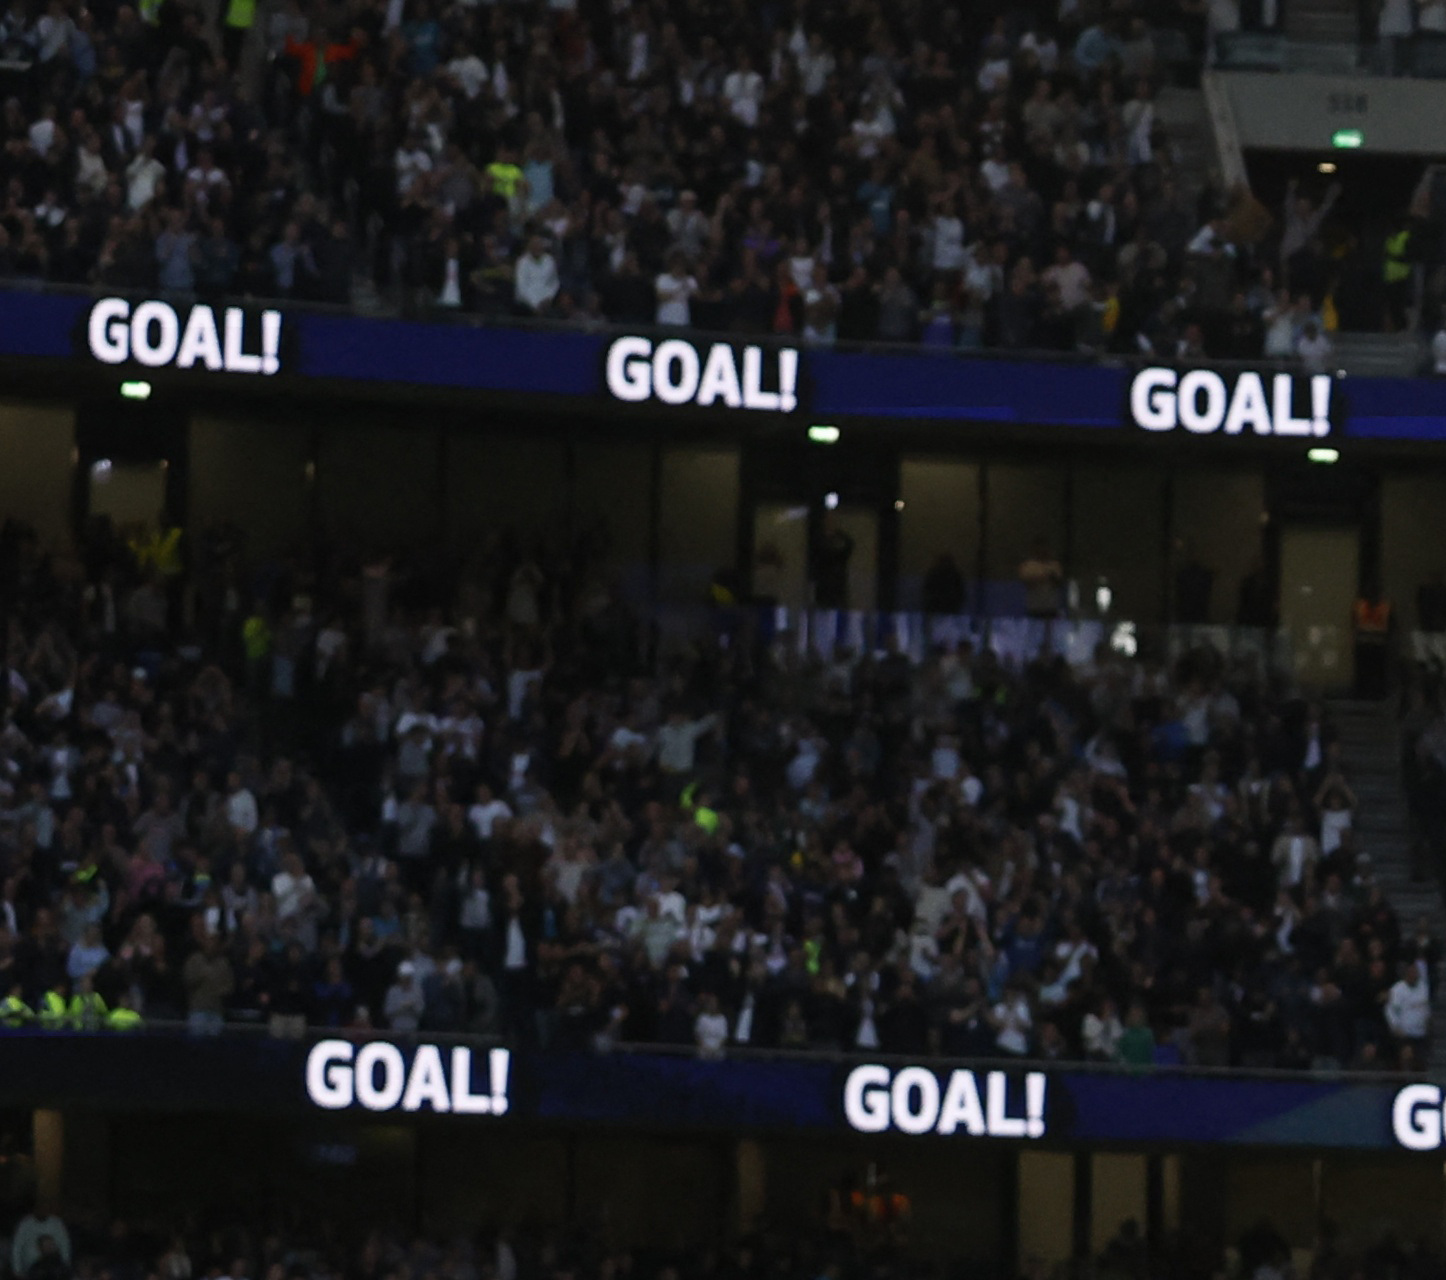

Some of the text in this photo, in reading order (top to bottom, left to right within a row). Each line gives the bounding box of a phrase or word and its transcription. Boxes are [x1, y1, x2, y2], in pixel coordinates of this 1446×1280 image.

[89, 298, 281, 374] GOAL!
[607, 336, 798, 412] GOAL!
[1131, 368, 1331, 437] GOAL!
[307, 1040, 510, 1115] GOAL!
[844, 1065, 1046, 1138] GOAL!
